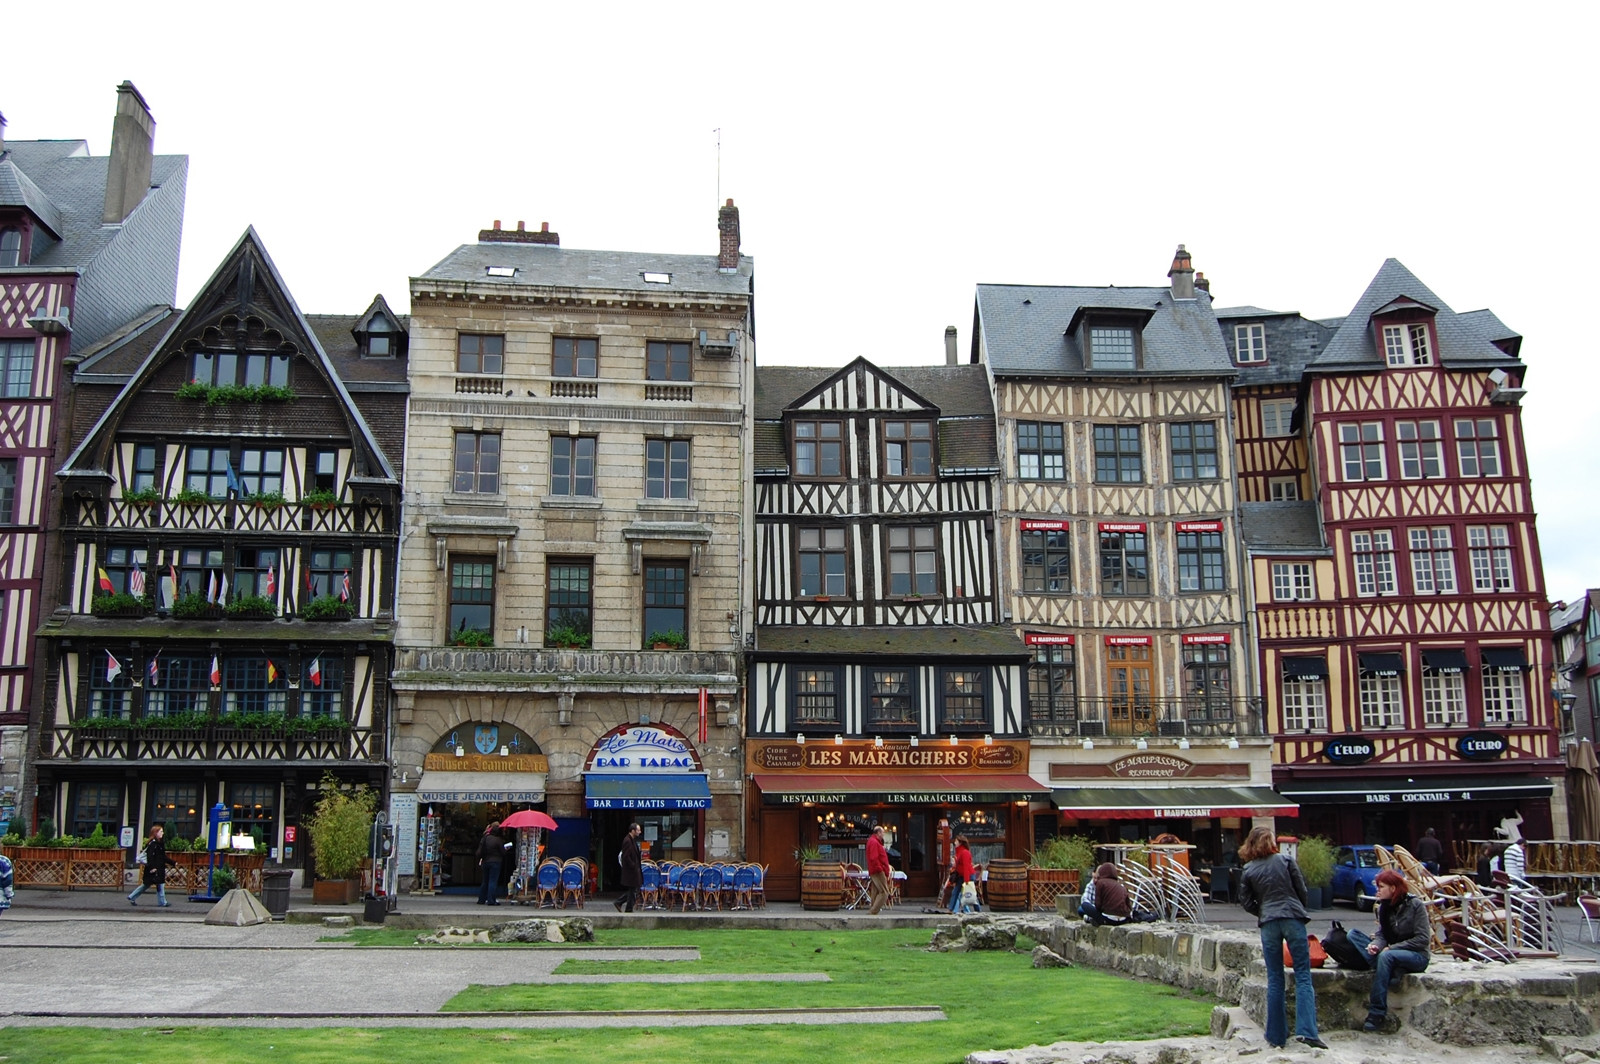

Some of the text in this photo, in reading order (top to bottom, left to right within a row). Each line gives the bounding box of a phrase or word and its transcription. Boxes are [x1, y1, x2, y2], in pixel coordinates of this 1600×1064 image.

[599, 729, 687, 753] Le Matis
[1467, 740, 1502, 750] L'EURO
[1335, 745, 1370, 755] L'EURO
[471, 755, 514, 771] Jeanne
[597, 757, 693, 767] BAR TABAC
[810, 751, 968, 765] LES MARAICHERS
[1115, 756, 1190, 772] LE MAUPASSANT
[1128, 769, 1175, 777] RESTAURANT
[422, 793, 540, 801] MUSEE JEANNE D'ARC
[782, 795, 846, 803] RESTAURANT
[888, 794, 905, 802] LES
[1366, 794, 1390, 802] BARS
[1402, 793, 1450, 801] COCKTAILS
[594, 800, 705, 808] BAR LE MATIS TABAC
[1154, 809, 1211, 817] LE MAUPASSANT
